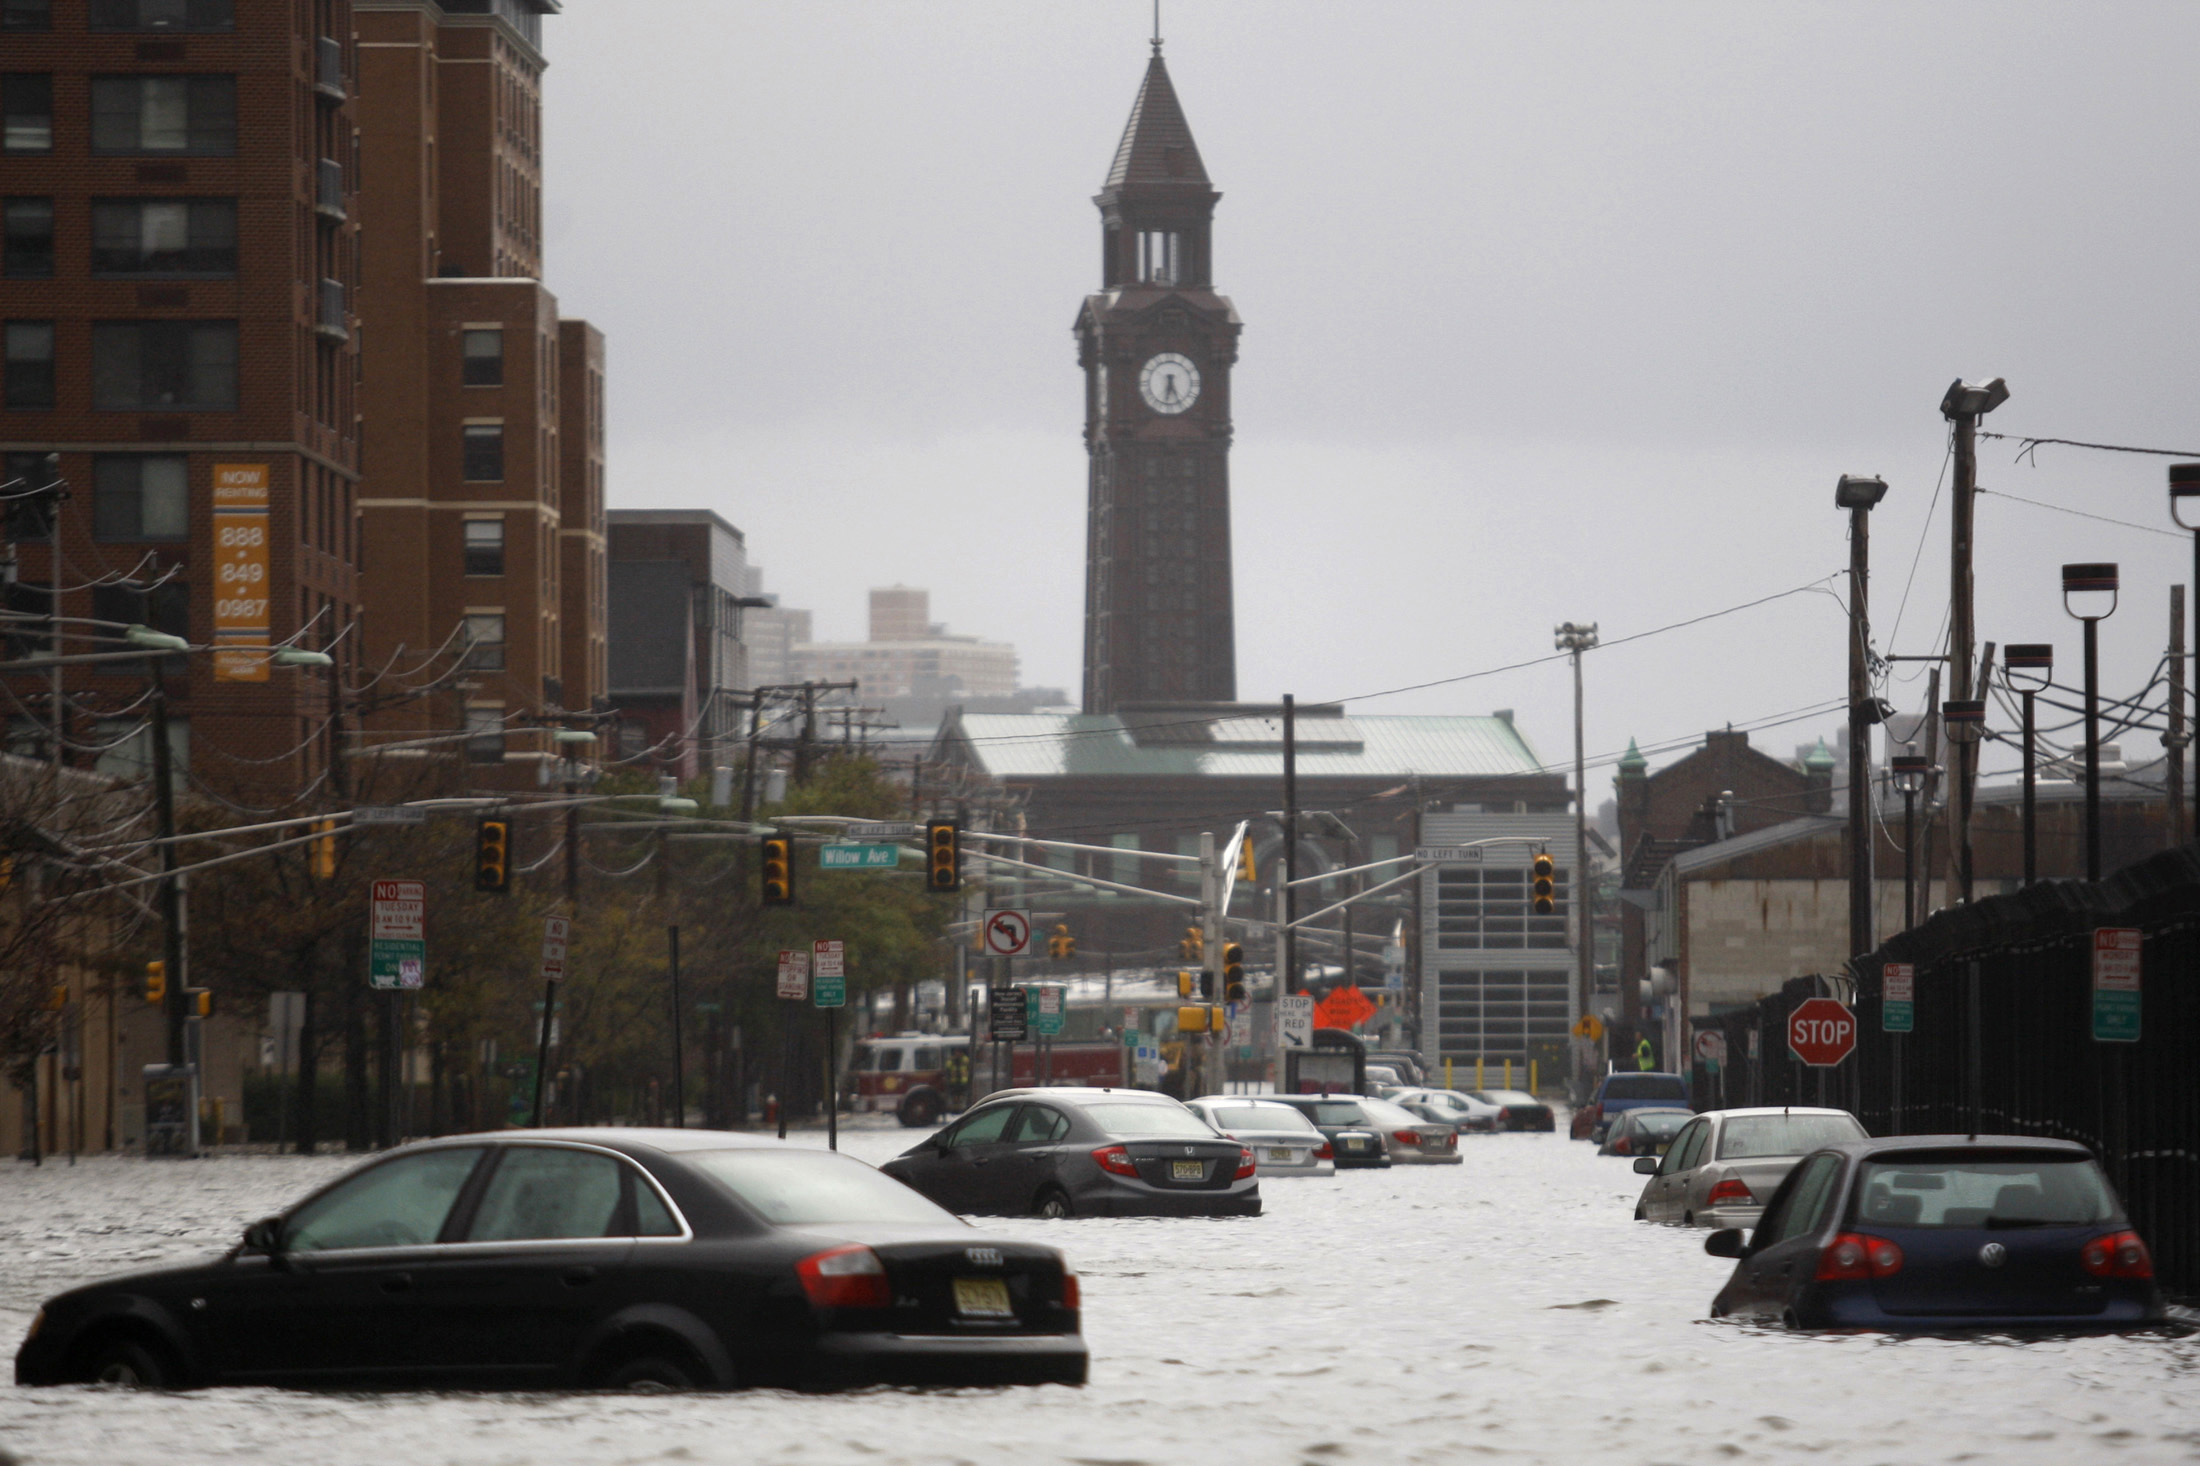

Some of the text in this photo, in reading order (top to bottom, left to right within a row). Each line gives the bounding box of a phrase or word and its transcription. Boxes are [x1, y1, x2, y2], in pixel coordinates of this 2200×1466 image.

[222, 471, 260, 484] NOW
[215, 487, 268, 497] RENTING
[221, 527, 263, 546] 888
[221, 563, 264, 582] 849
[217, 599, 267, 617] 0987
[825, 849, 860, 865] Willow
[1417, 849, 1479, 859] NO LEFT TURN
[377, 884, 397, 899] NO
[381, 902, 419, 912] TUESDAY
[383, 915, 393, 923] AM
[551, 921, 563, 935] NO
[816, 942, 828, 950] NO
[2099, 933, 2117, 948] NO
[374, 942, 420, 952] RESIDENTIAL
[1887, 967, 1898, 976] NO
[1282, 999, 1310, 1009] STOP
[1285, 1018, 1305, 1029] RED
[1794, 1019, 1850, 1045] STOP
